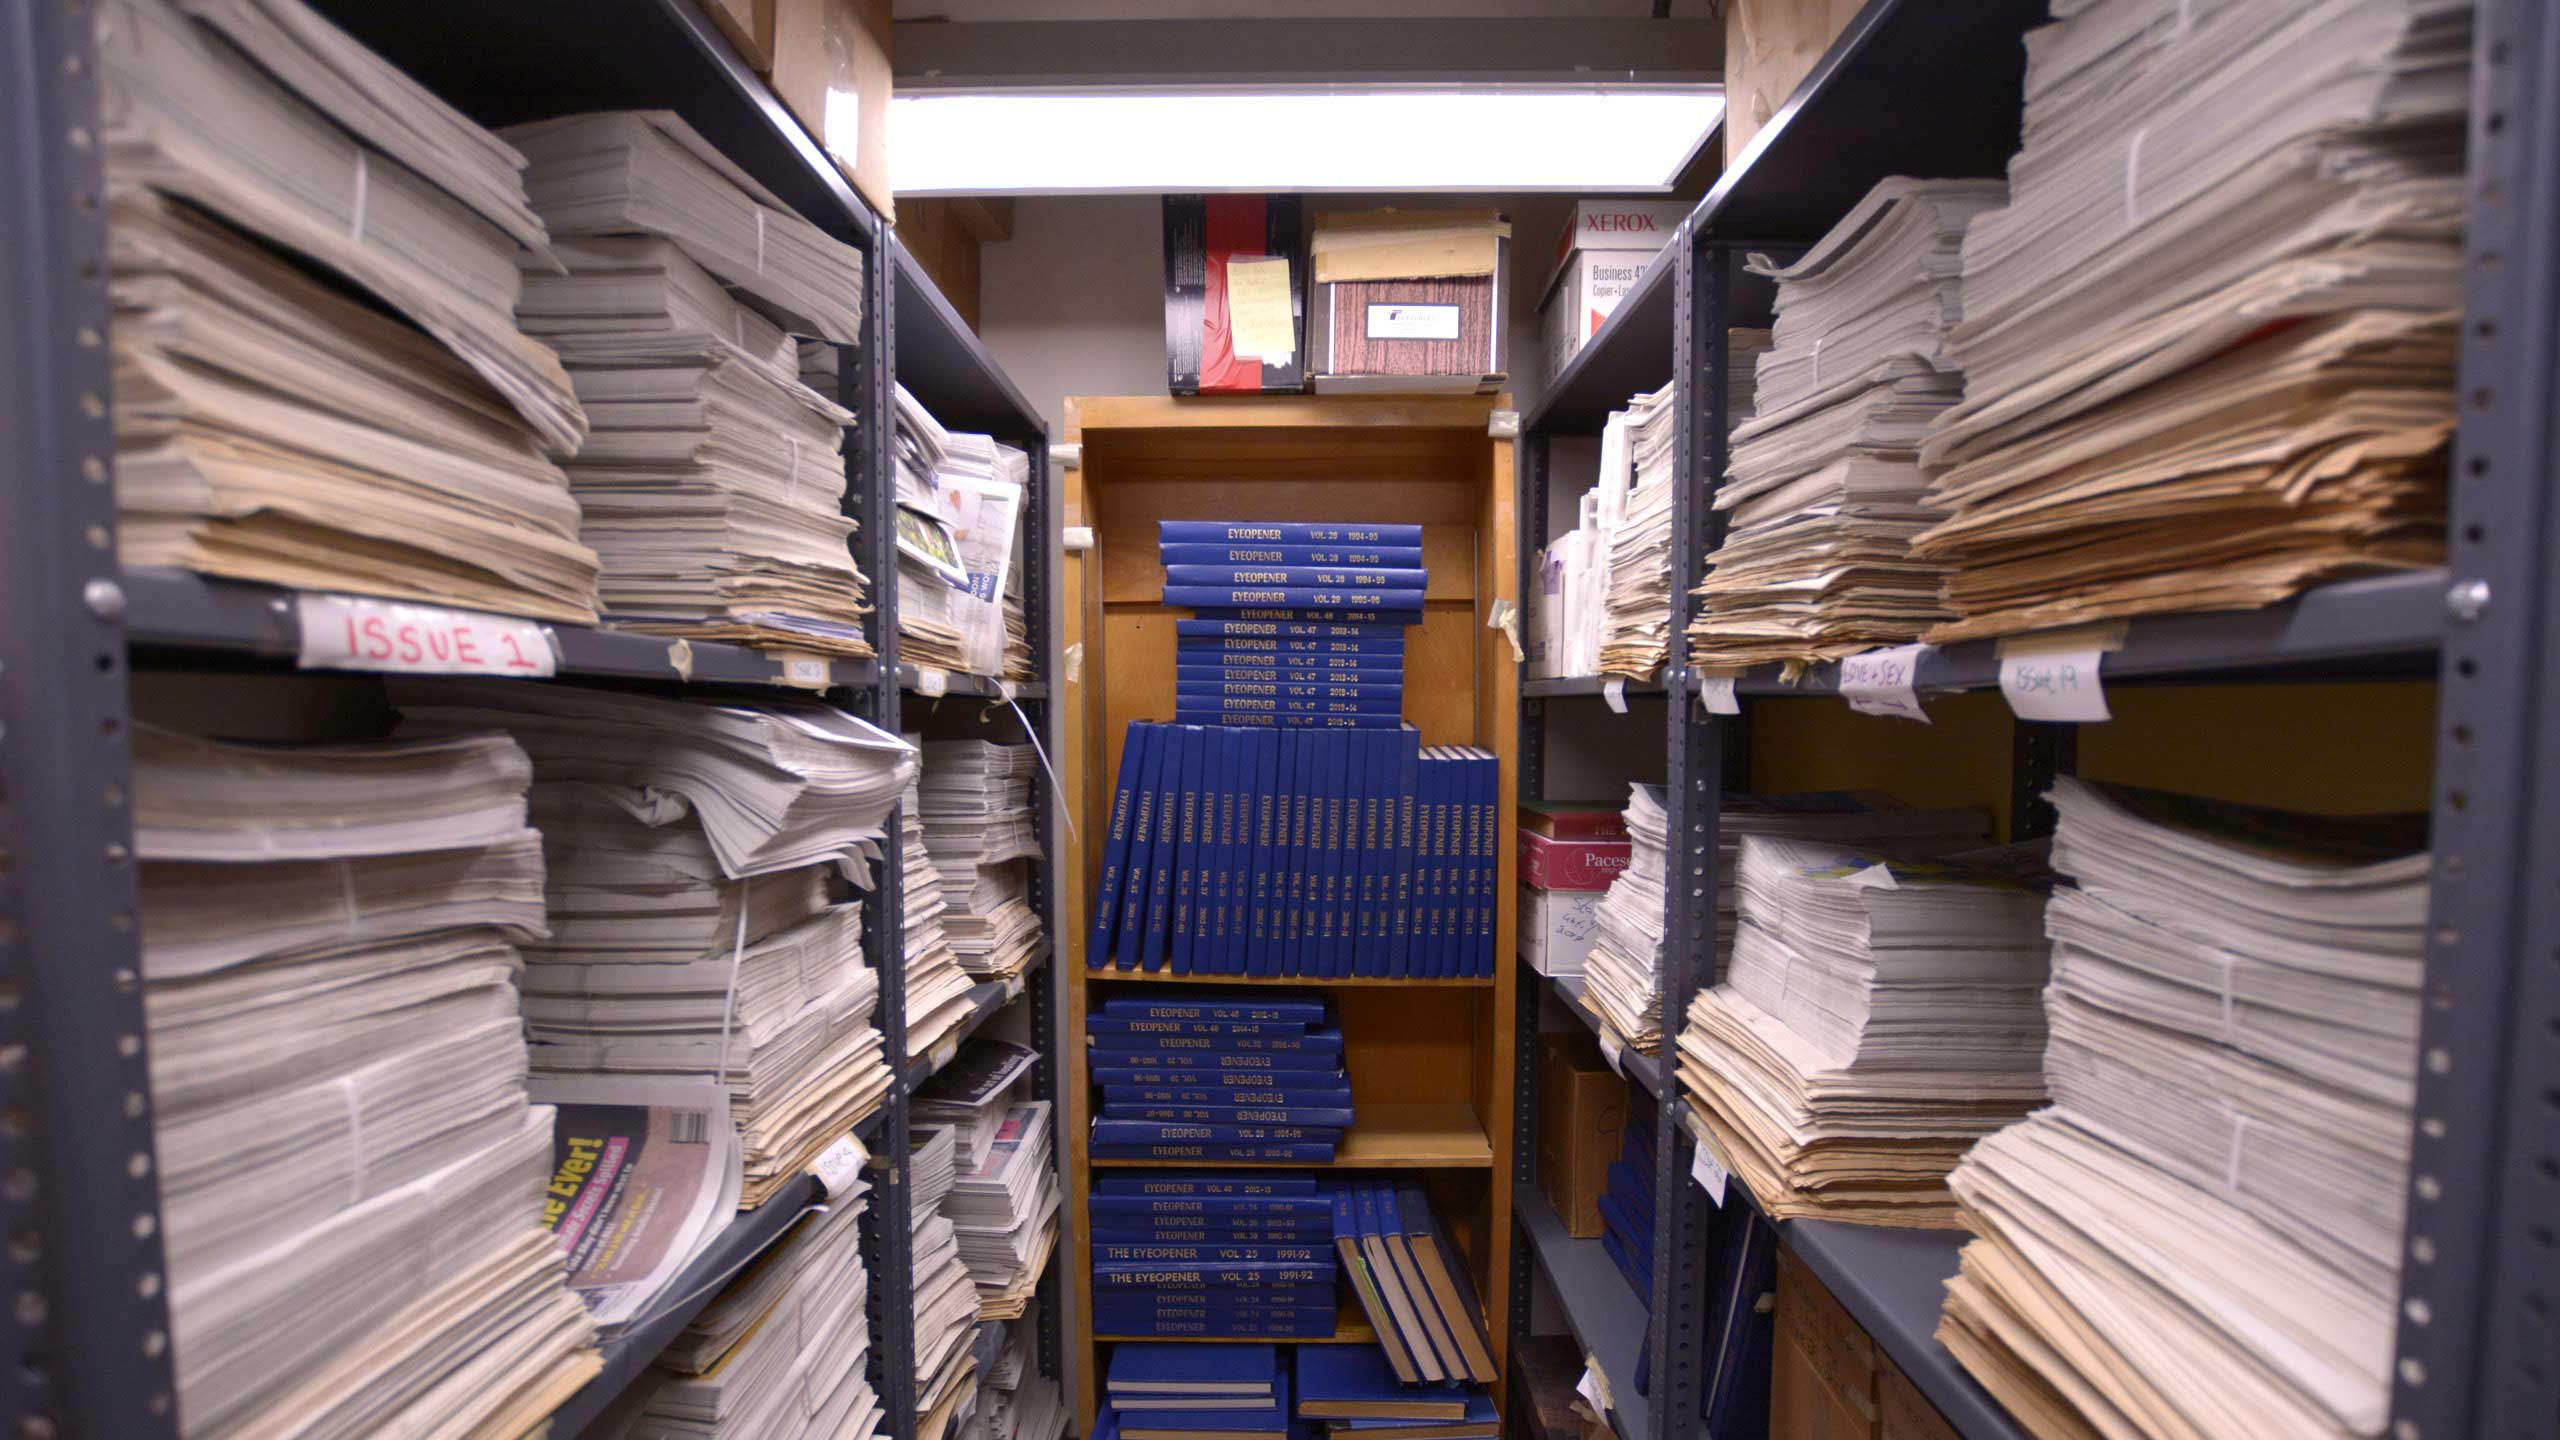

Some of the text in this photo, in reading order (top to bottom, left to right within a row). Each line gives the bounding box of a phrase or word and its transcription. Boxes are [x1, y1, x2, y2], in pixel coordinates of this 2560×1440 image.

[1587, 213, 1656, 232] XEROX
[1593, 265, 1633, 281] Business
[1228, 529, 1281, 540] EYEOPENER
[1230, 551, 1282, 562] EYEOPENER
[1234, 572, 1287, 583] EYEOPENER
[1232, 592, 1285, 602] EYEOPENER
[1241, 609, 1294, 620] EYEOPENER
[1225, 623, 1277, 634] EYEOPENER
[346, 614, 537, 669] ISSUE 1
[1225, 639, 1277, 650] EYEOPENER
[1224, 655, 1275, 665] EYEOPENER
[1225, 670, 1276, 680] EYEOPENER
[1878, 660, 1906, 687] SEX
[1225, 684, 1276, 695] EYEOPENER
[1224, 699, 1276, 710] EYEOPENER
[1222, 715, 1274, 725] EYEOPENER
[1113, 789, 1129, 840] EYEOPENER
[1137, 791, 1151, 842] EYEOPENER
[1161, 792, 1174, 843] EYEOPENER
[1183, 792, 1194, 842] EYEOPENER
[1203, 792, 1214, 843] EYEOPENER
[1222, 794, 1232, 845] EYEOPENER
[1239, 793, 1249, 844] EYEOPENER
[1260, 795, 1271, 846] EYEOPENER
[1278, 795, 1289, 846] EYEOPENER
[1295, 795, 1306, 846] EYEOPENER
[1312, 798, 1322, 848] EYEOPENER
[1328, 799, 1339, 849] EYEOPENER
[1347, 799, 1358, 849] EYEOPENER
[1366, 799, 1377, 848] EYEOPENER
[1384, 799, 1394, 848] EYEOPENER
[1401, 796, 1413, 847] EYEOPENER
[1418, 805, 1429, 856] EYEOPENER
[1435, 805, 1446, 856] EYEOPENER
[1451, 805, 1462, 856] EYEOPENER
[1469, 805, 1479, 855] EYEOPENER
[1484, 805, 1494, 856] EYEOPENER
[1150, 1008, 1200, 1018] EYEOPENER
[1130, 1023, 1181, 1032] EYEOPENER
[1160, 1038, 1211, 1048] EYEOPENER
[1221, 1056, 1271, 1067] EYEOPENER
[1223, 1074, 1273, 1085] EYEOPENER
[1234, 1093, 1283, 1103] EYEOPENER
[1237, 1111, 1287, 1121] EYEOPENER
[1161, 1128, 1212, 1138] EYEOPENER
[1152, 1145, 1202, 1156] EYEOPENER
[548, 1137, 603, 1198] Ever!
[1144, 1184, 1194, 1193] EYEOPENER
[1152, 1202, 1203, 1211] EYEOPENER
[1155, 1217, 1205, 1226] EYEOPENER
[1156, 1232, 1205, 1240] EYEOPENER
[1108, 1248, 1128, 1259] THE
[1133, 1248, 1198, 1259] EYEOPENER
[1246, 1250, 1258, 1259] 25
[1277, 1250, 1311, 1259] 1991-92
[1111, 1274, 1132, 1283] THE
[1136, 1272, 1201, 1282] EYEOPENER
[1248, 1272, 1260, 1280] 25
[1279, 1271, 1313, 1280] 1991-92
[1156, 1323, 1205, 1331] EYEOPENER
